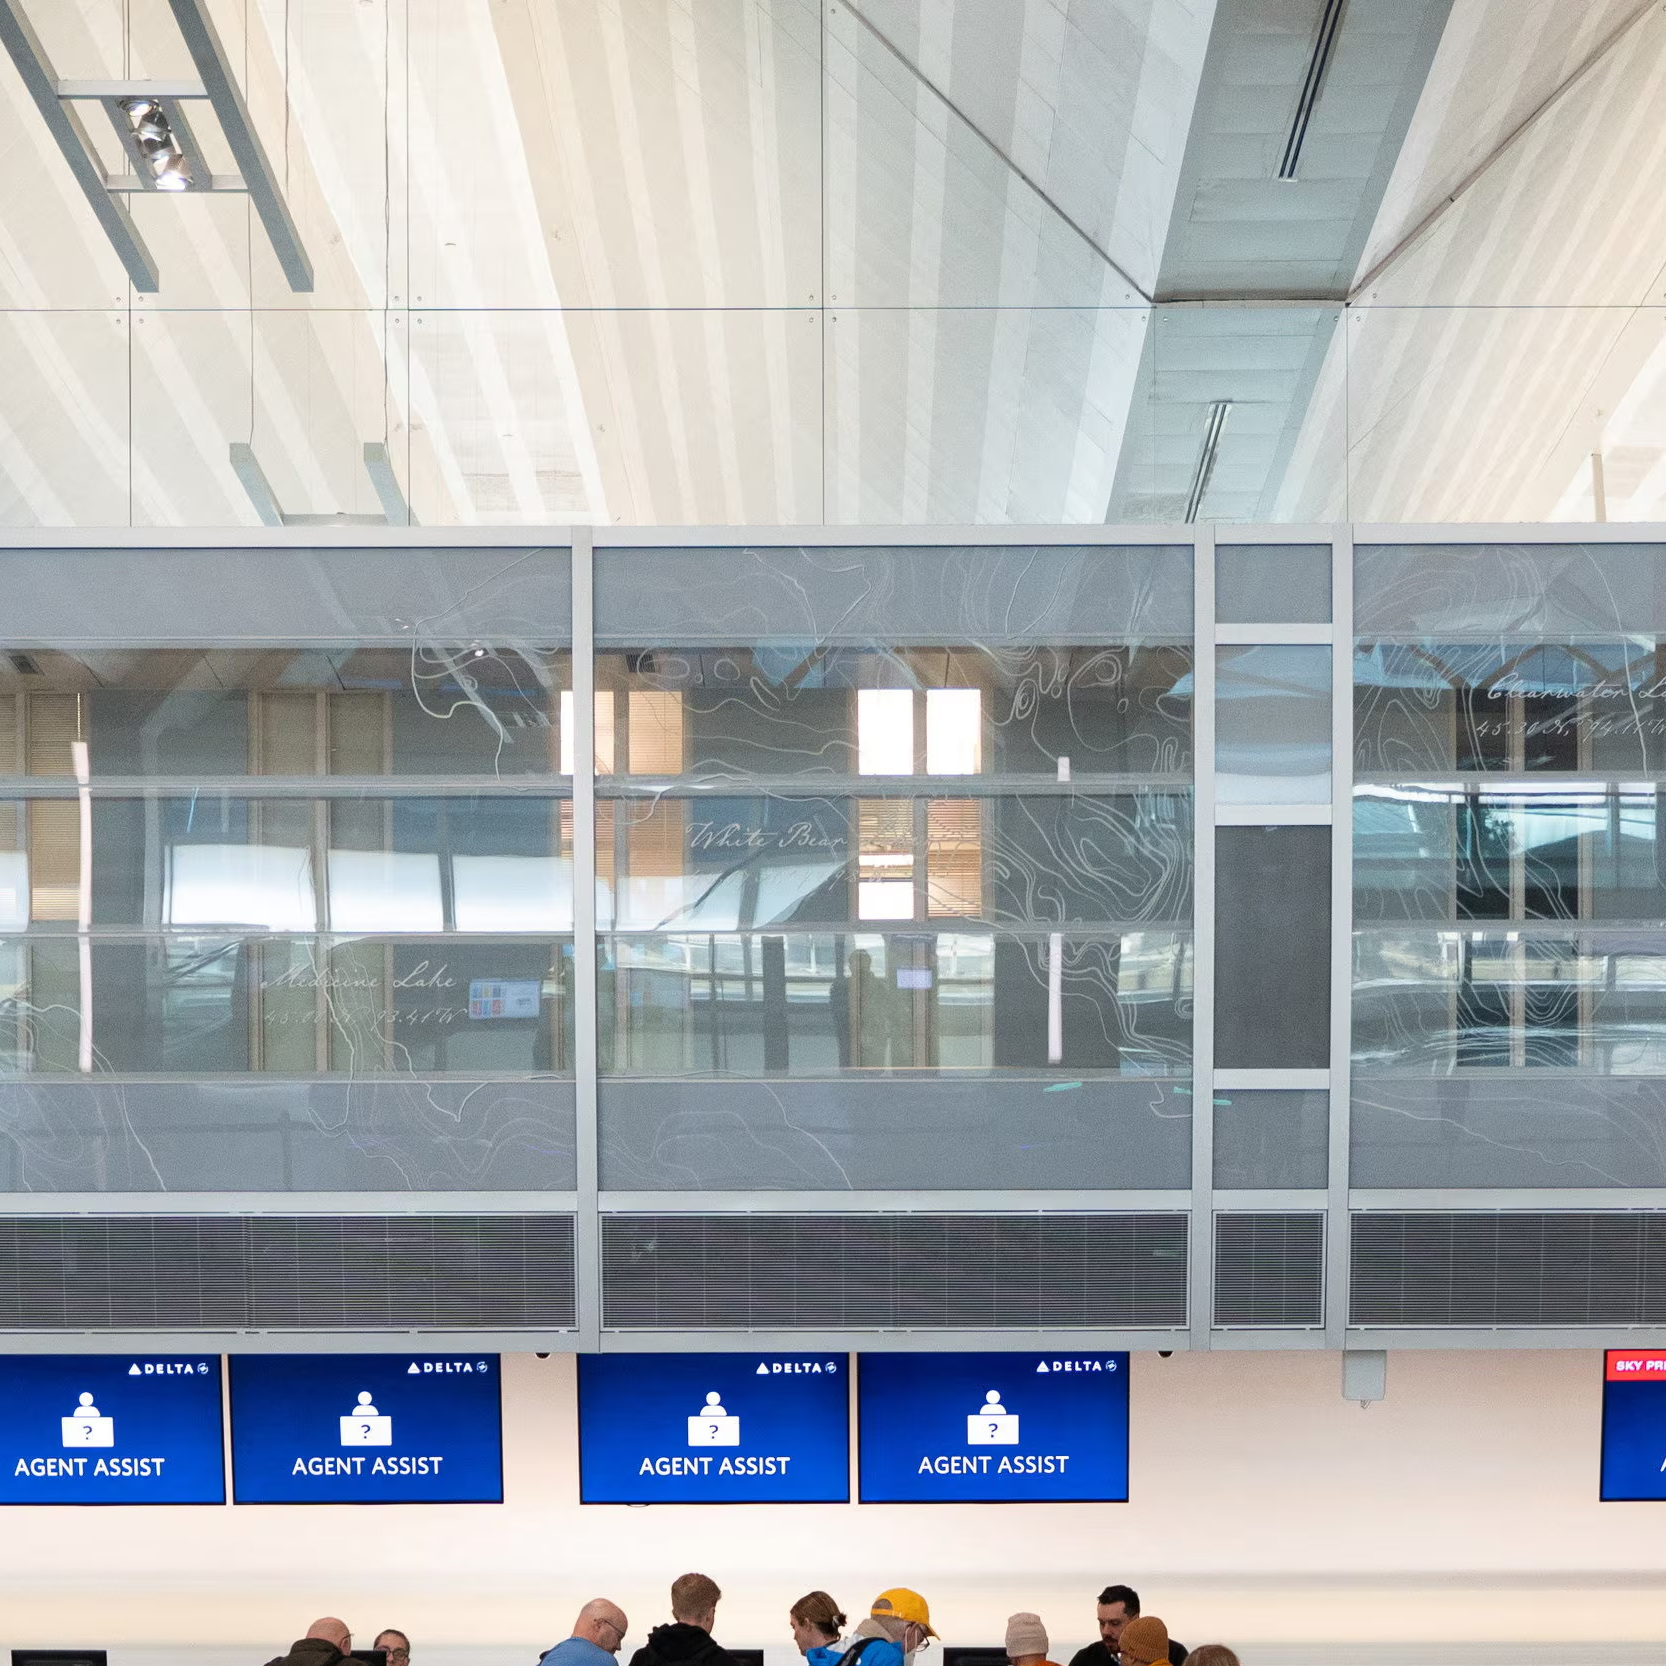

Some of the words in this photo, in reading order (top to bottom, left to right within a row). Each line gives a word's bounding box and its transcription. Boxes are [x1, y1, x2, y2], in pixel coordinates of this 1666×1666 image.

[1487, 671, 1630, 700] Clearwater
[685, 821, 779, 850] White
[778, 821, 847, 849] Bear
[261, 963, 382, 989] Medicine
[393, 960, 457, 988] Lake
[145, 1364, 193, 1374] DELTA
[424, 1363, 472, 1372] DELTA
[773, 1363, 821, 1373] DELTA
[1053, 1361, 1101, 1371] DELTA
[1617, 1361, 1642, 1370] SKY
[15, 1458, 87, 1476] AGENT
[94, 1458, 165, 1476] ASSIST
[293, 1458, 365, 1475] AGENT
[372, 1457, 443, 1474] ASSIST
[639, 1457, 713, 1475] AGENT
[719, 1457, 790, 1475] ASSIST
[919, 1456, 992, 1474] AGENT
[998, 1456, 1069, 1473] ASSIST
